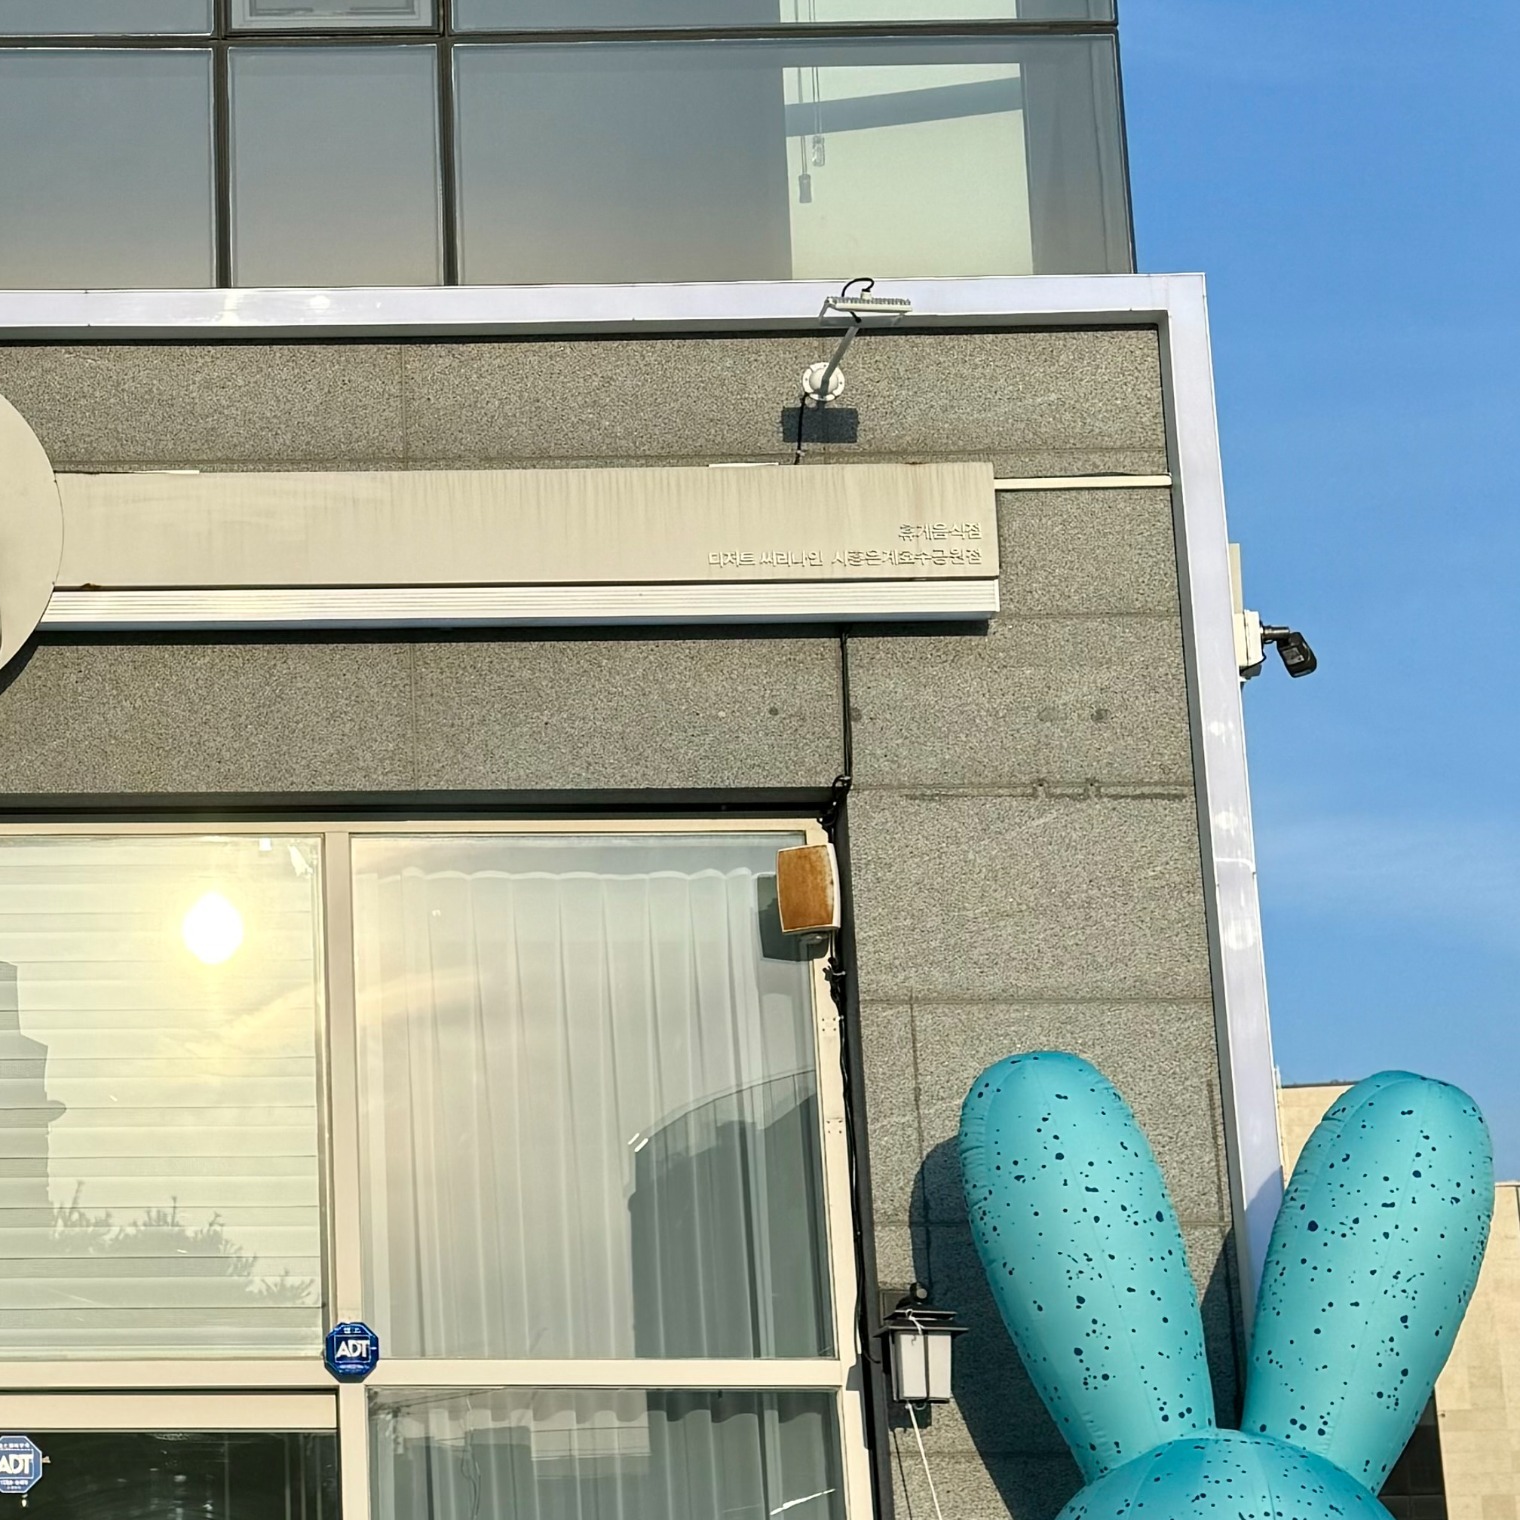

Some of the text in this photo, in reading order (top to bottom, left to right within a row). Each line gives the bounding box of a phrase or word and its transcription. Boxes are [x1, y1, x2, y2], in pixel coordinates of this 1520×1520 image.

[898, 522, 982, 541] 휴게음식점
[708, 548, 756, 568] 디저트
[335, 1339, 371, 1358] ADT
